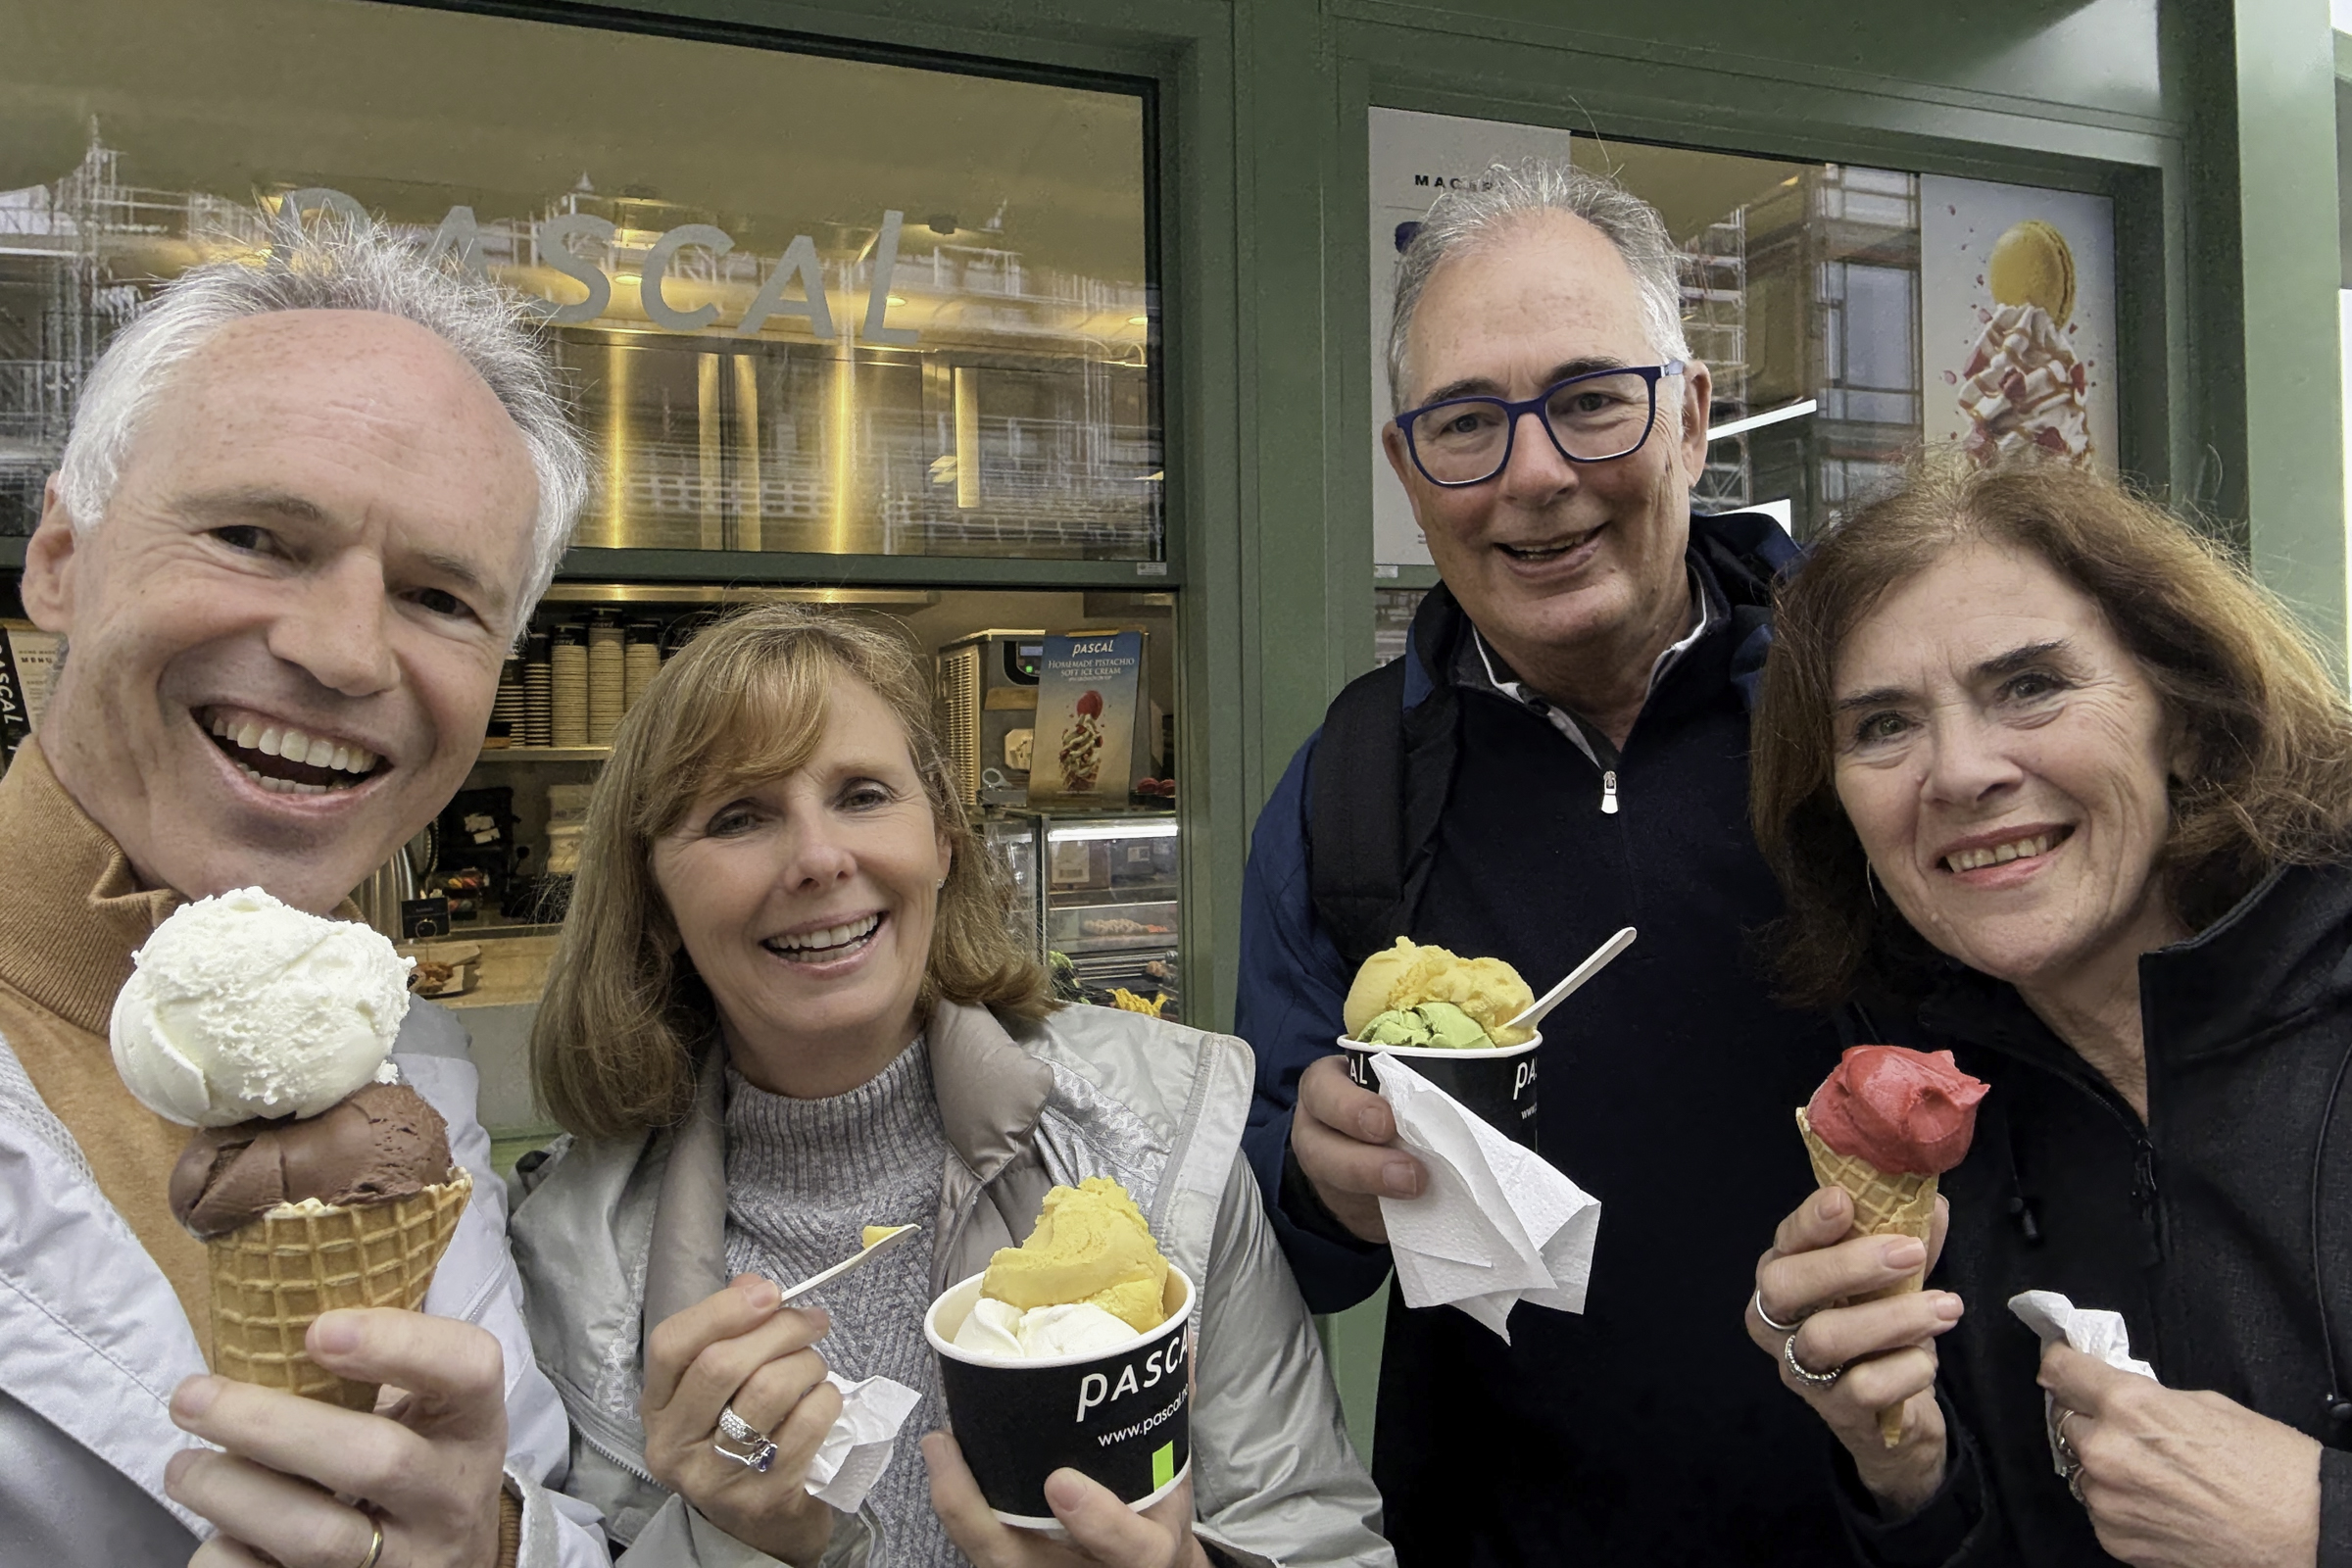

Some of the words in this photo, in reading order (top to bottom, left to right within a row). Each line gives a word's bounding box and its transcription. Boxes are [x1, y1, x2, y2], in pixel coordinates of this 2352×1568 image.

[1071, 639, 1114, 658] PASCAL
[1048, 660, 1093, 669] HOMEMADE
[1095, 658, 1135, 667] PISTACHIO
[1347, 1054, 1368, 1085] AL
[1512, 1056, 1537, 1101] PA
